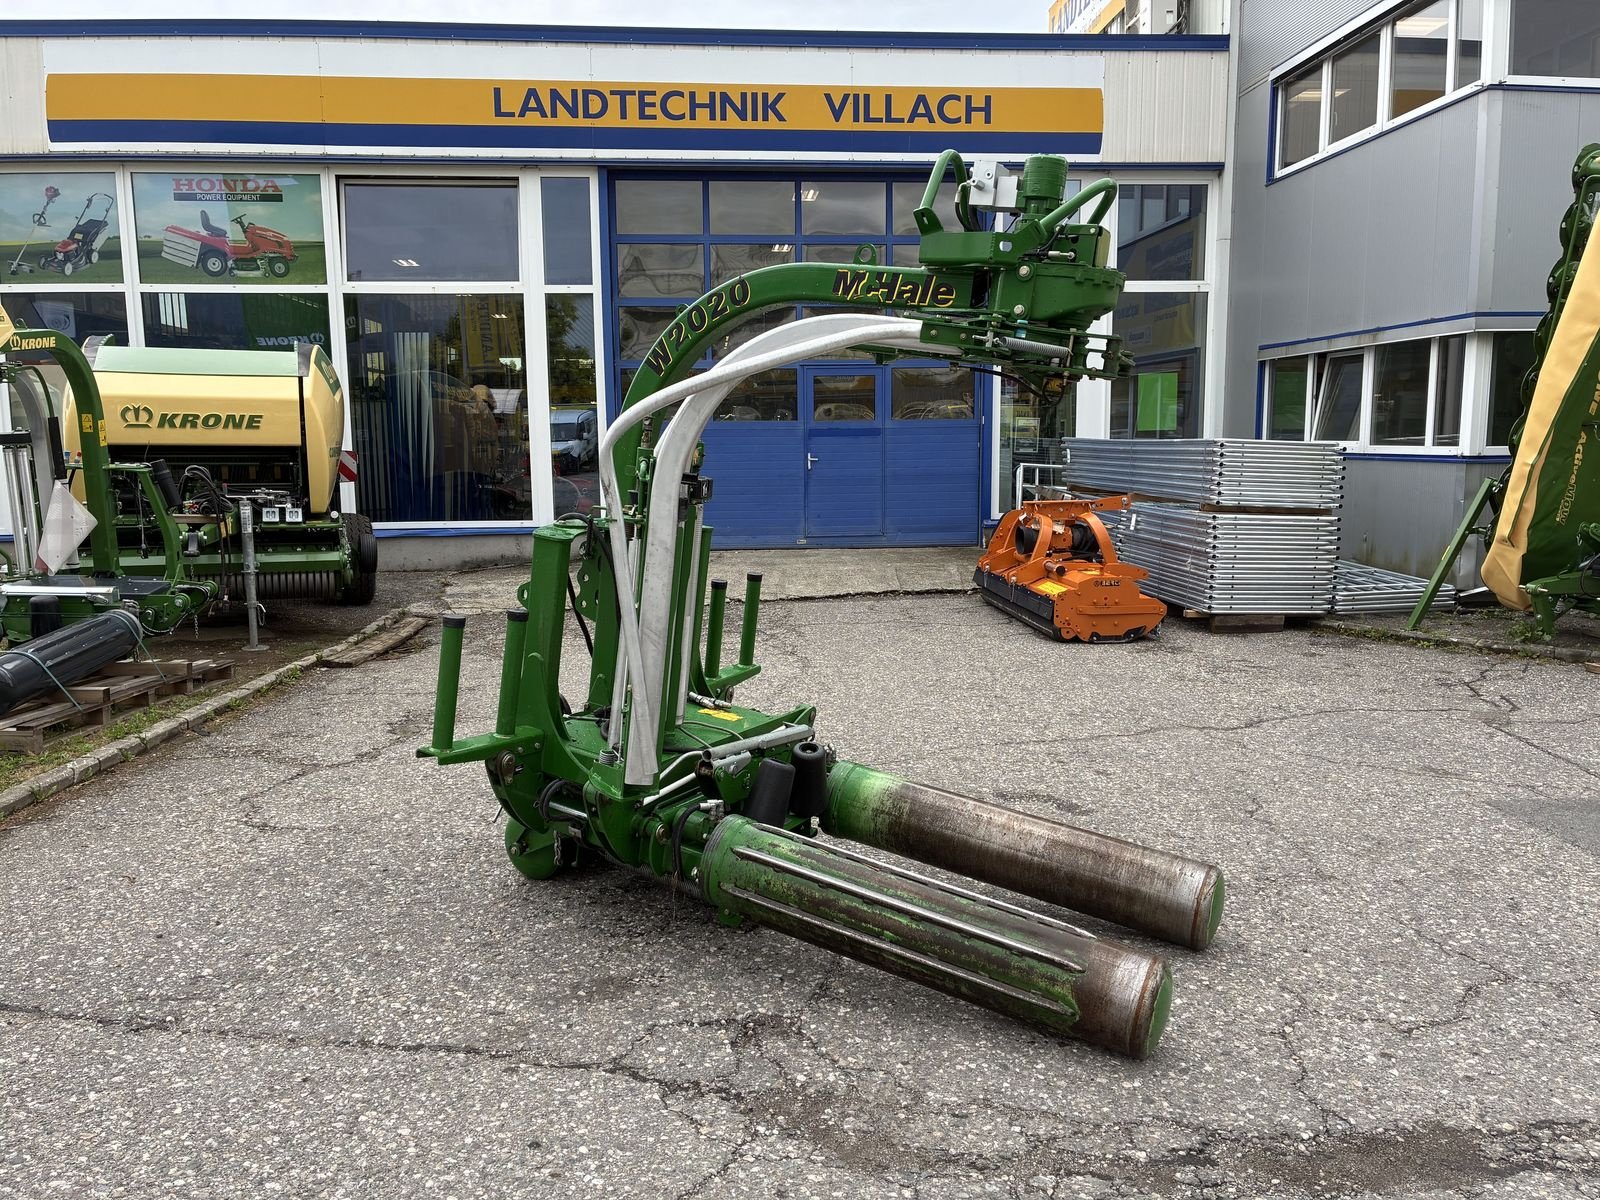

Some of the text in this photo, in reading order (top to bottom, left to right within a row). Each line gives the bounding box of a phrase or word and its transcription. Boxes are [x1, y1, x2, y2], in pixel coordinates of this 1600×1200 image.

[493, 87, 992, 125] LANDTECHNIK VILLACH
[172, 178, 282, 192] HONDA
[196, 193, 260, 201] POWER EQUIPMENT
[832, 269, 956, 308] McHale
[646, 278, 752, 377] W2020
[21, 336, 56, 350] KRONE
[156, 412, 264, 430] KRONE
